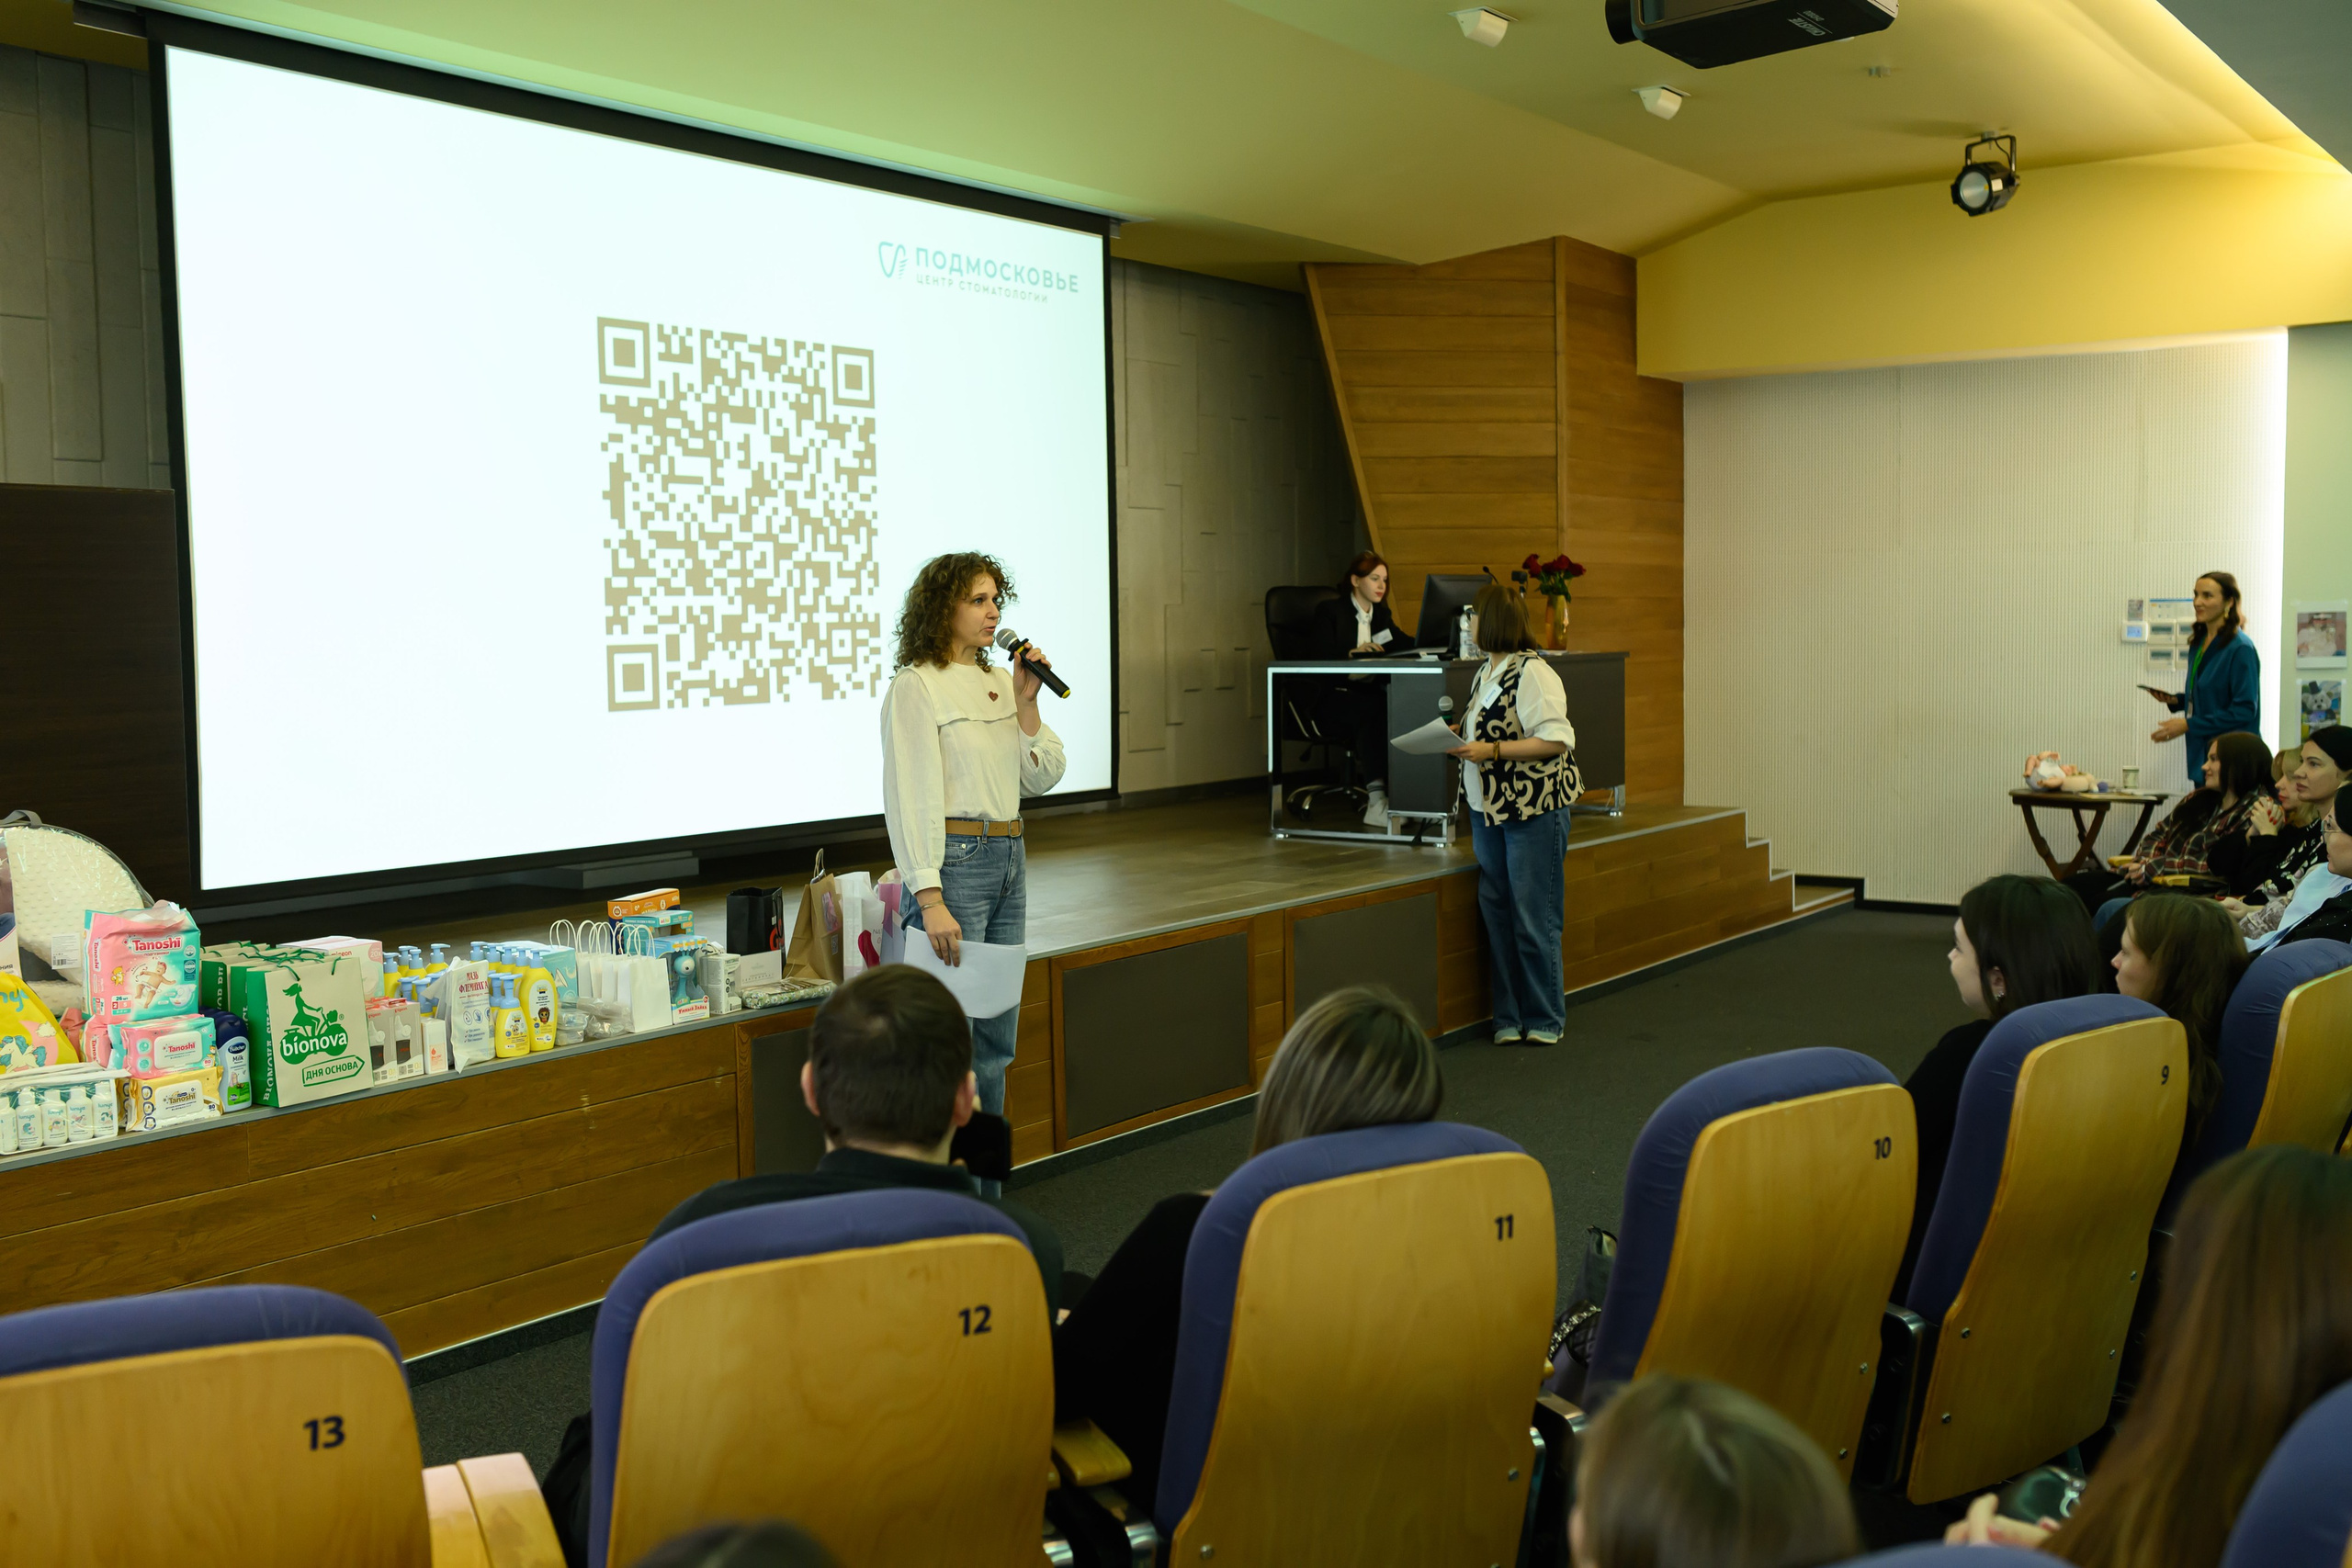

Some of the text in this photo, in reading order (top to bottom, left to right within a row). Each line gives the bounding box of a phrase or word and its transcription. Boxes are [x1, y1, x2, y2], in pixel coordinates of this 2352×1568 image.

[916, 247, 1079, 293] ПОДМОСКОВЬЕ
[916, 274, 1048, 303] ЦЕНТР СТОМАТОЛОГИИ
[466, 971, 479, 981] МАЗЬ
[282, 1032, 348, 1057] bionova
[306, 1061, 358, 1081] ДНЯ ОСНОВА
[2161, 1065, 2170, 1086] 9
[1873, 1136, 1893, 1160] 10
[1495, 1213, 1514, 1241] 11
[958, 1304, 992, 1337] 12
[303, 1415, 346, 1451] 13
